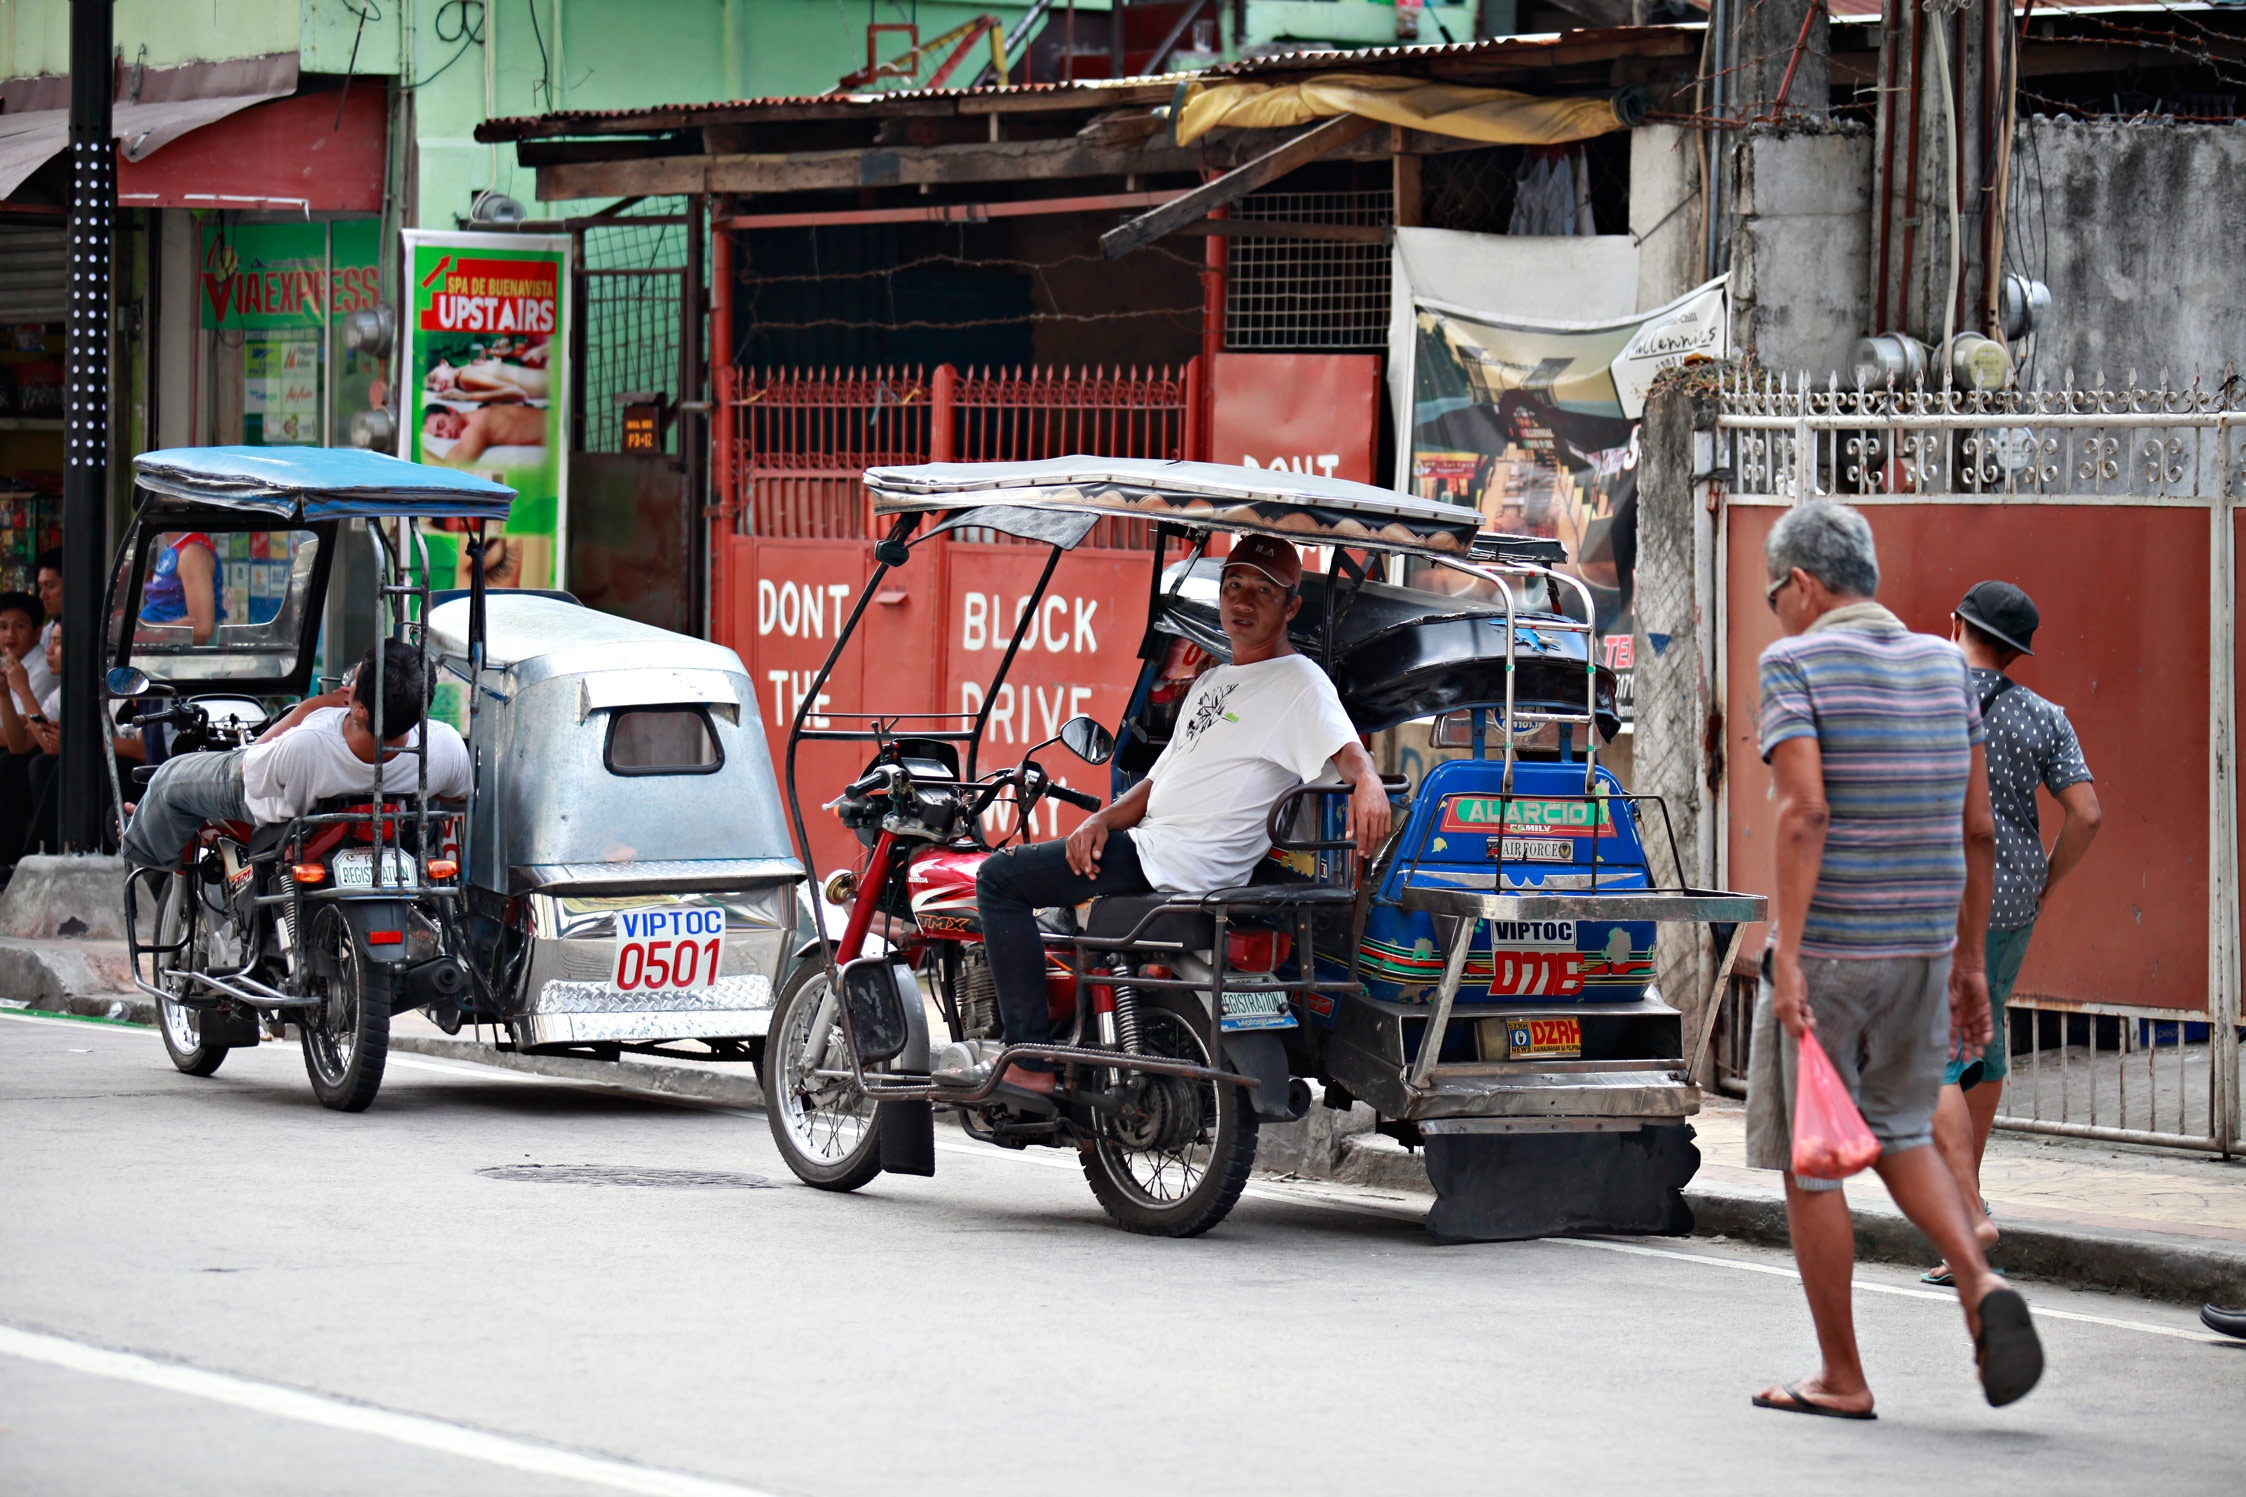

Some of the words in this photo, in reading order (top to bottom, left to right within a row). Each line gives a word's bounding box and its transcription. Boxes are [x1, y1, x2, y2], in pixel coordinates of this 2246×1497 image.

[447, 276, 469, 295] SPA
[471, 278, 486, 296] DE
[488, 278, 554, 298] BUENAVISTA
[438, 294, 555, 333] UPSTAIRS
[758, 578, 850, 639] DONT
[963, 591, 1099, 654] BLOCK
[768, 670, 831, 729] THE
[962, 681, 1093, 745] DRIVE
[1468, 801, 1588, 825] ALARCIO
[1509, 824, 1552, 832] FAMILY
[343, 866, 410, 884] REGISTATIN
[908, 876, 928, 884] HONDA
[622, 910, 722, 938] VIPTOC
[916, 913, 971, 932] TMX
[1494, 921, 1573, 941] VIPTOC
[616, 938, 721, 991] 0501
[1530, 1020, 1583, 1045] DZRH
[1511, 1046, 1531, 1054] NEWS
